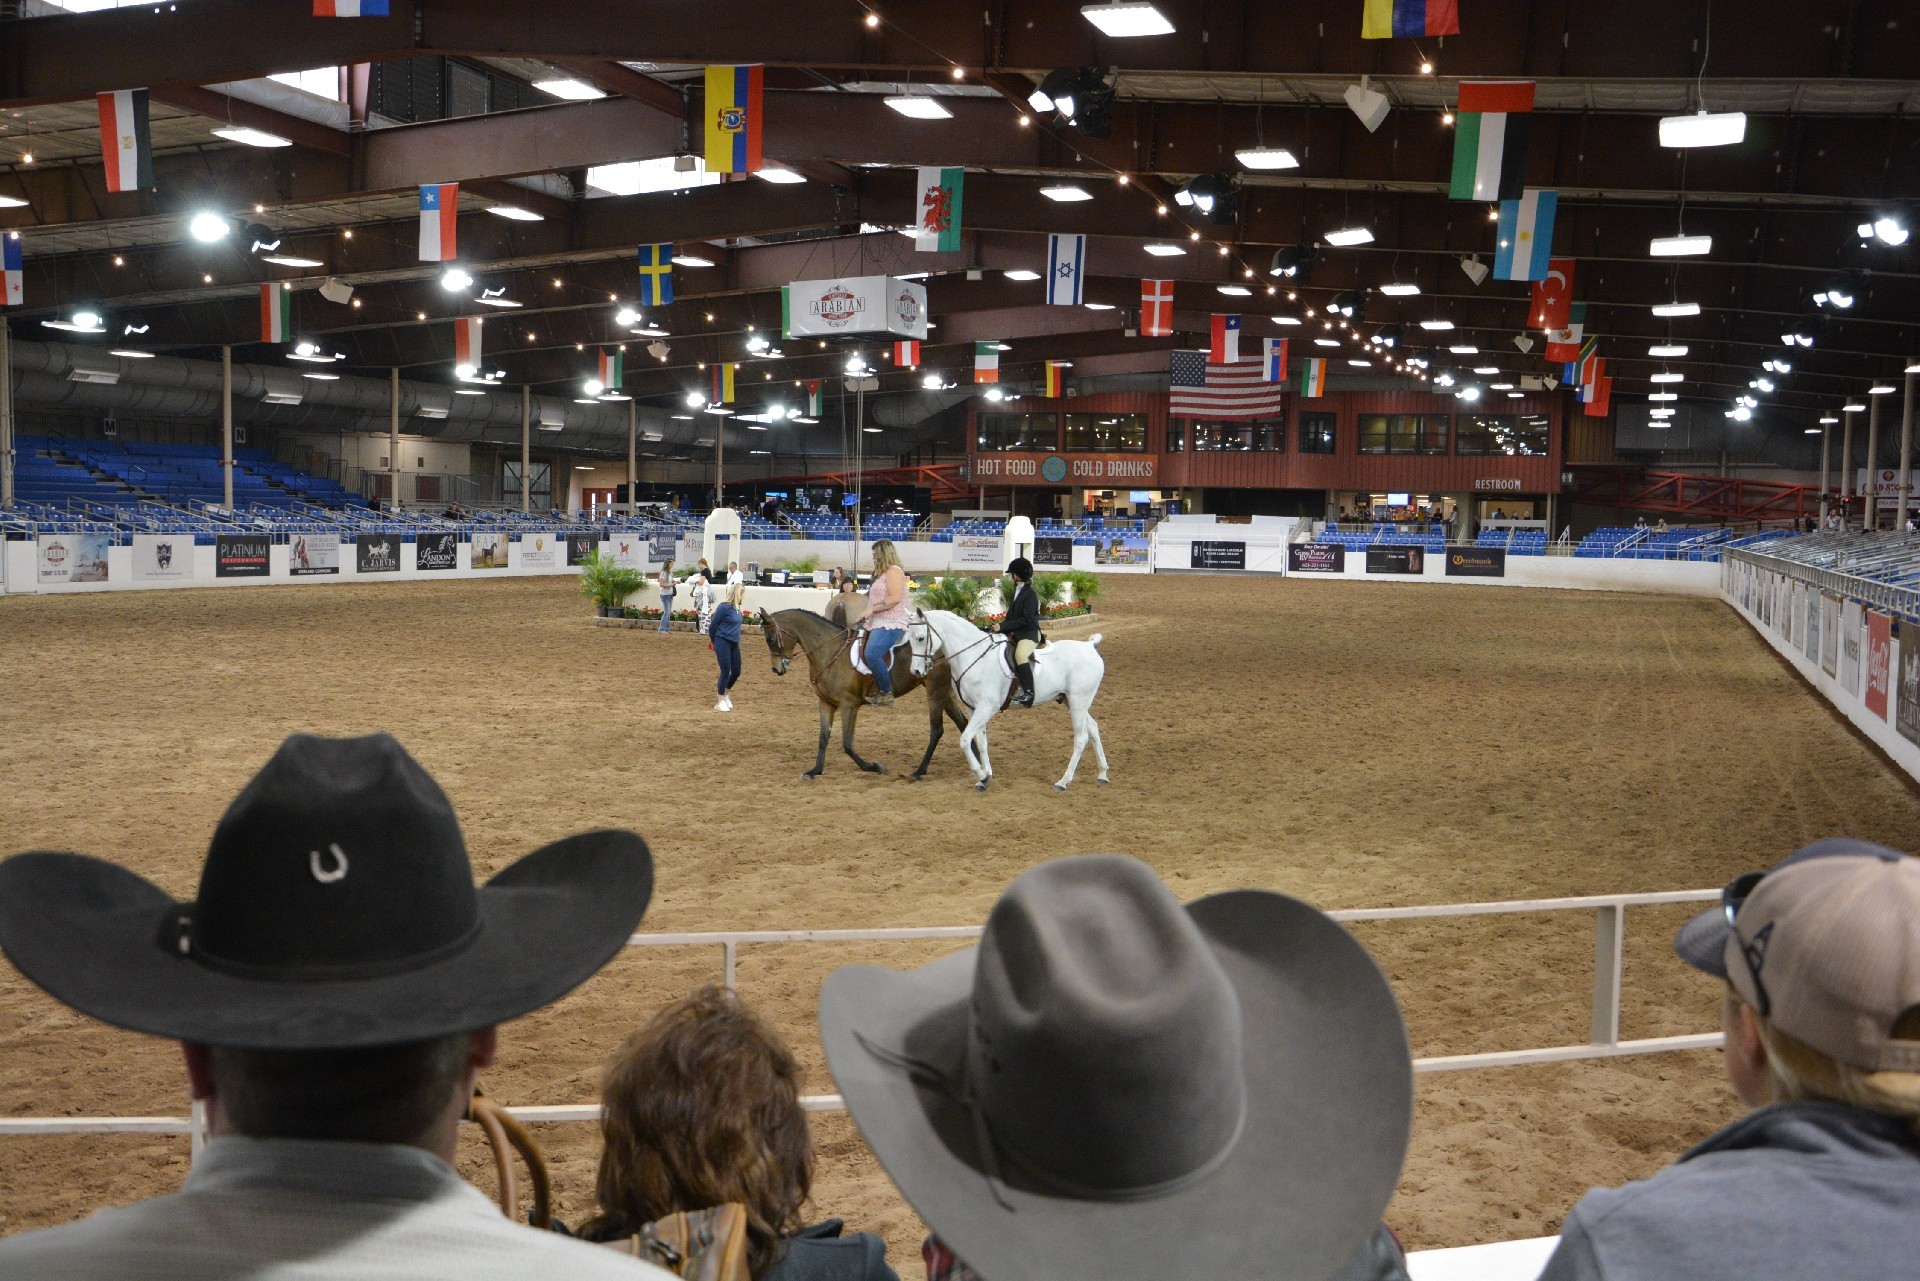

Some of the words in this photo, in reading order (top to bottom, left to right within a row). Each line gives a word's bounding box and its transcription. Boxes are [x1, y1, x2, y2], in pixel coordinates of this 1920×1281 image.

[813, 299, 862, 314] ARABIAN
[977, 459, 1001, 475] HOT
[1005, 459, 1036, 476] FOOD
[1073, 460, 1103, 477] COLD
[1107, 461, 1153, 477] DRINKS
[1475, 479, 1521, 490] RESTROOM
[221, 543, 266, 558] PLATINUM
[361, 559, 369, 568] C.
[370, 558, 396, 567] JARVIS
